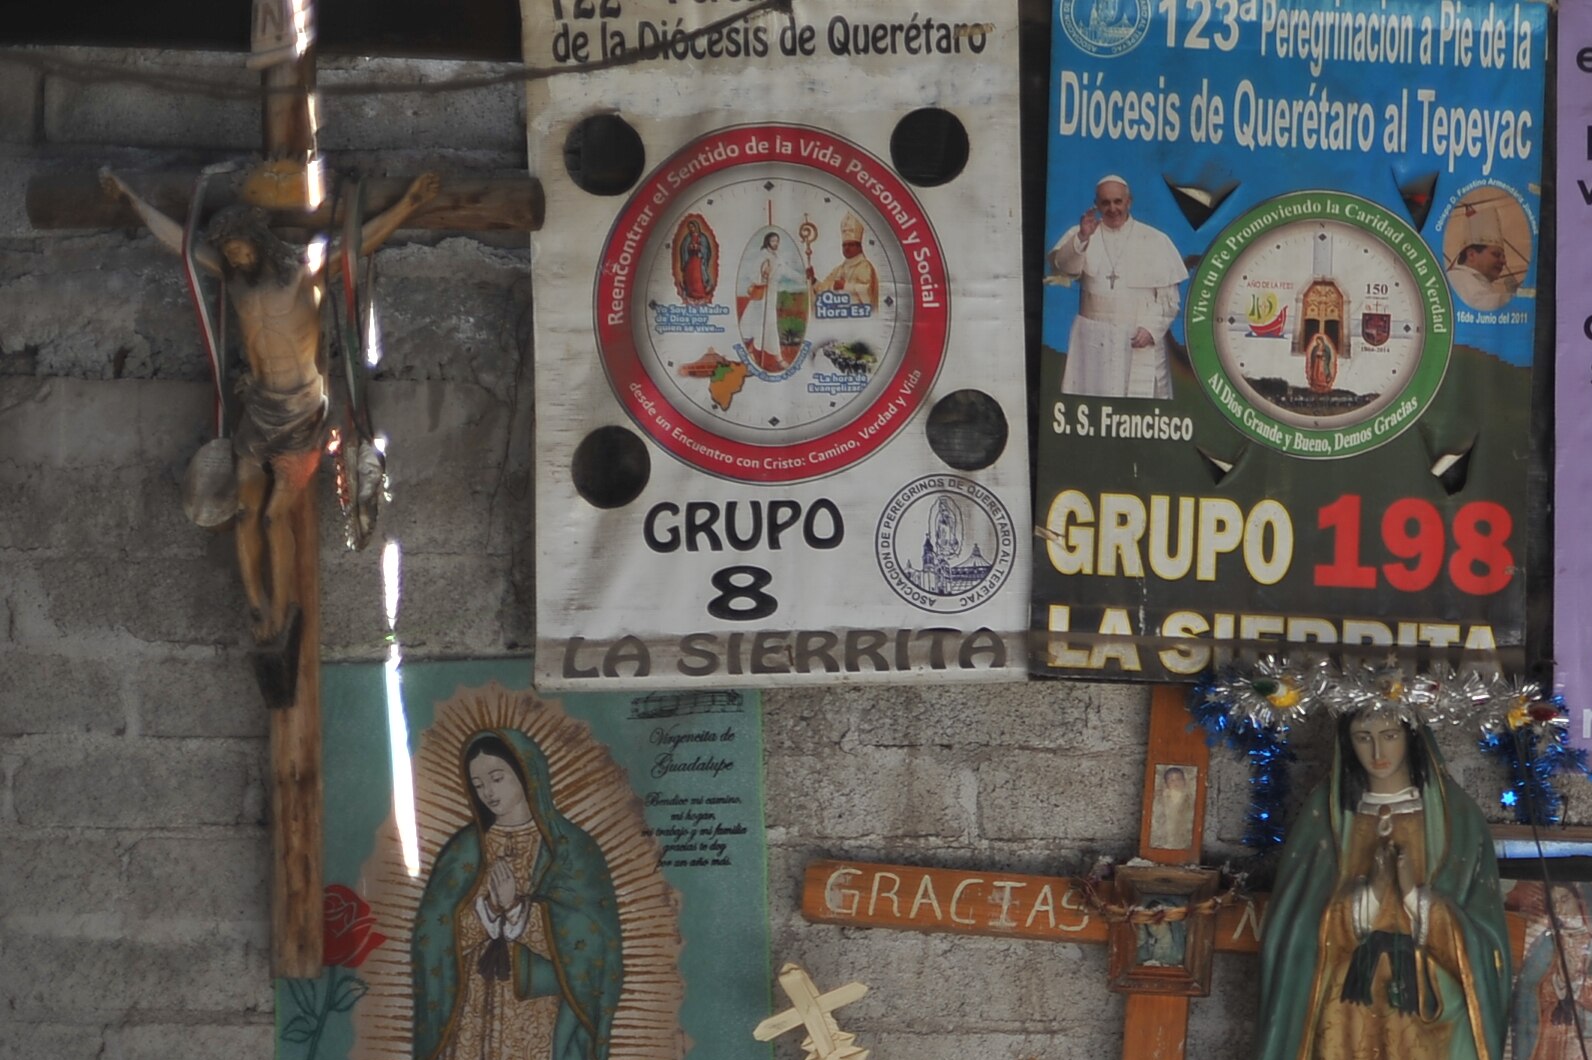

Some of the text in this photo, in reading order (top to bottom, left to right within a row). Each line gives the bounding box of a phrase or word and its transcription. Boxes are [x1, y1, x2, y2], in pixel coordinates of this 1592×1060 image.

[552, 13, 988, 63] de la Diócesis de Querétaro
[1420, 16, 1432, 65] a
[1439, 0, 1473, 67] Pie
[1479, 2, 1506, 69] de
[1513, 3, 1531, 70] la
[1059, 71, 1532, 176] Diócesis de Querétaro al Tepeyac
[608, 135, 940, 326] Reencontrar el Sentido de la Vida Personal y Social
[1192, 199, 1448, 335] Vive tu Fe Promoviendo la Caridad en la Verdad
[1366, 283, 1389, 295] 150
[817, 305, 871, 318] Hora Es?
[629, 369, 922, 470] desde un Encuentro con Cristo: Camino, Verdad y Vida
[1053, 401, 1193, 442] S. S. Francisco
[1208, 372, 1418, 455] Al Dios Grande y Bueno, Demos Gracias
[644, 498, 845, 553] GRUPO
[881, 478, 1012, 607] ASOCIACION DE PEREGRINOS DE QUERETARO AL TEPEYAC
[1046, 489, 1514, 596] GRUPO 198
[707, 565, 778, 621] 8
[563, 627, 1008, 679] LA SIERRITA
[1047, 604, 1142, 672] LA
[650, 752, 735, 780] Guadalupe
[720, 726, 736, 743] de
[825, 867, 1092, 934] GRACIAS
